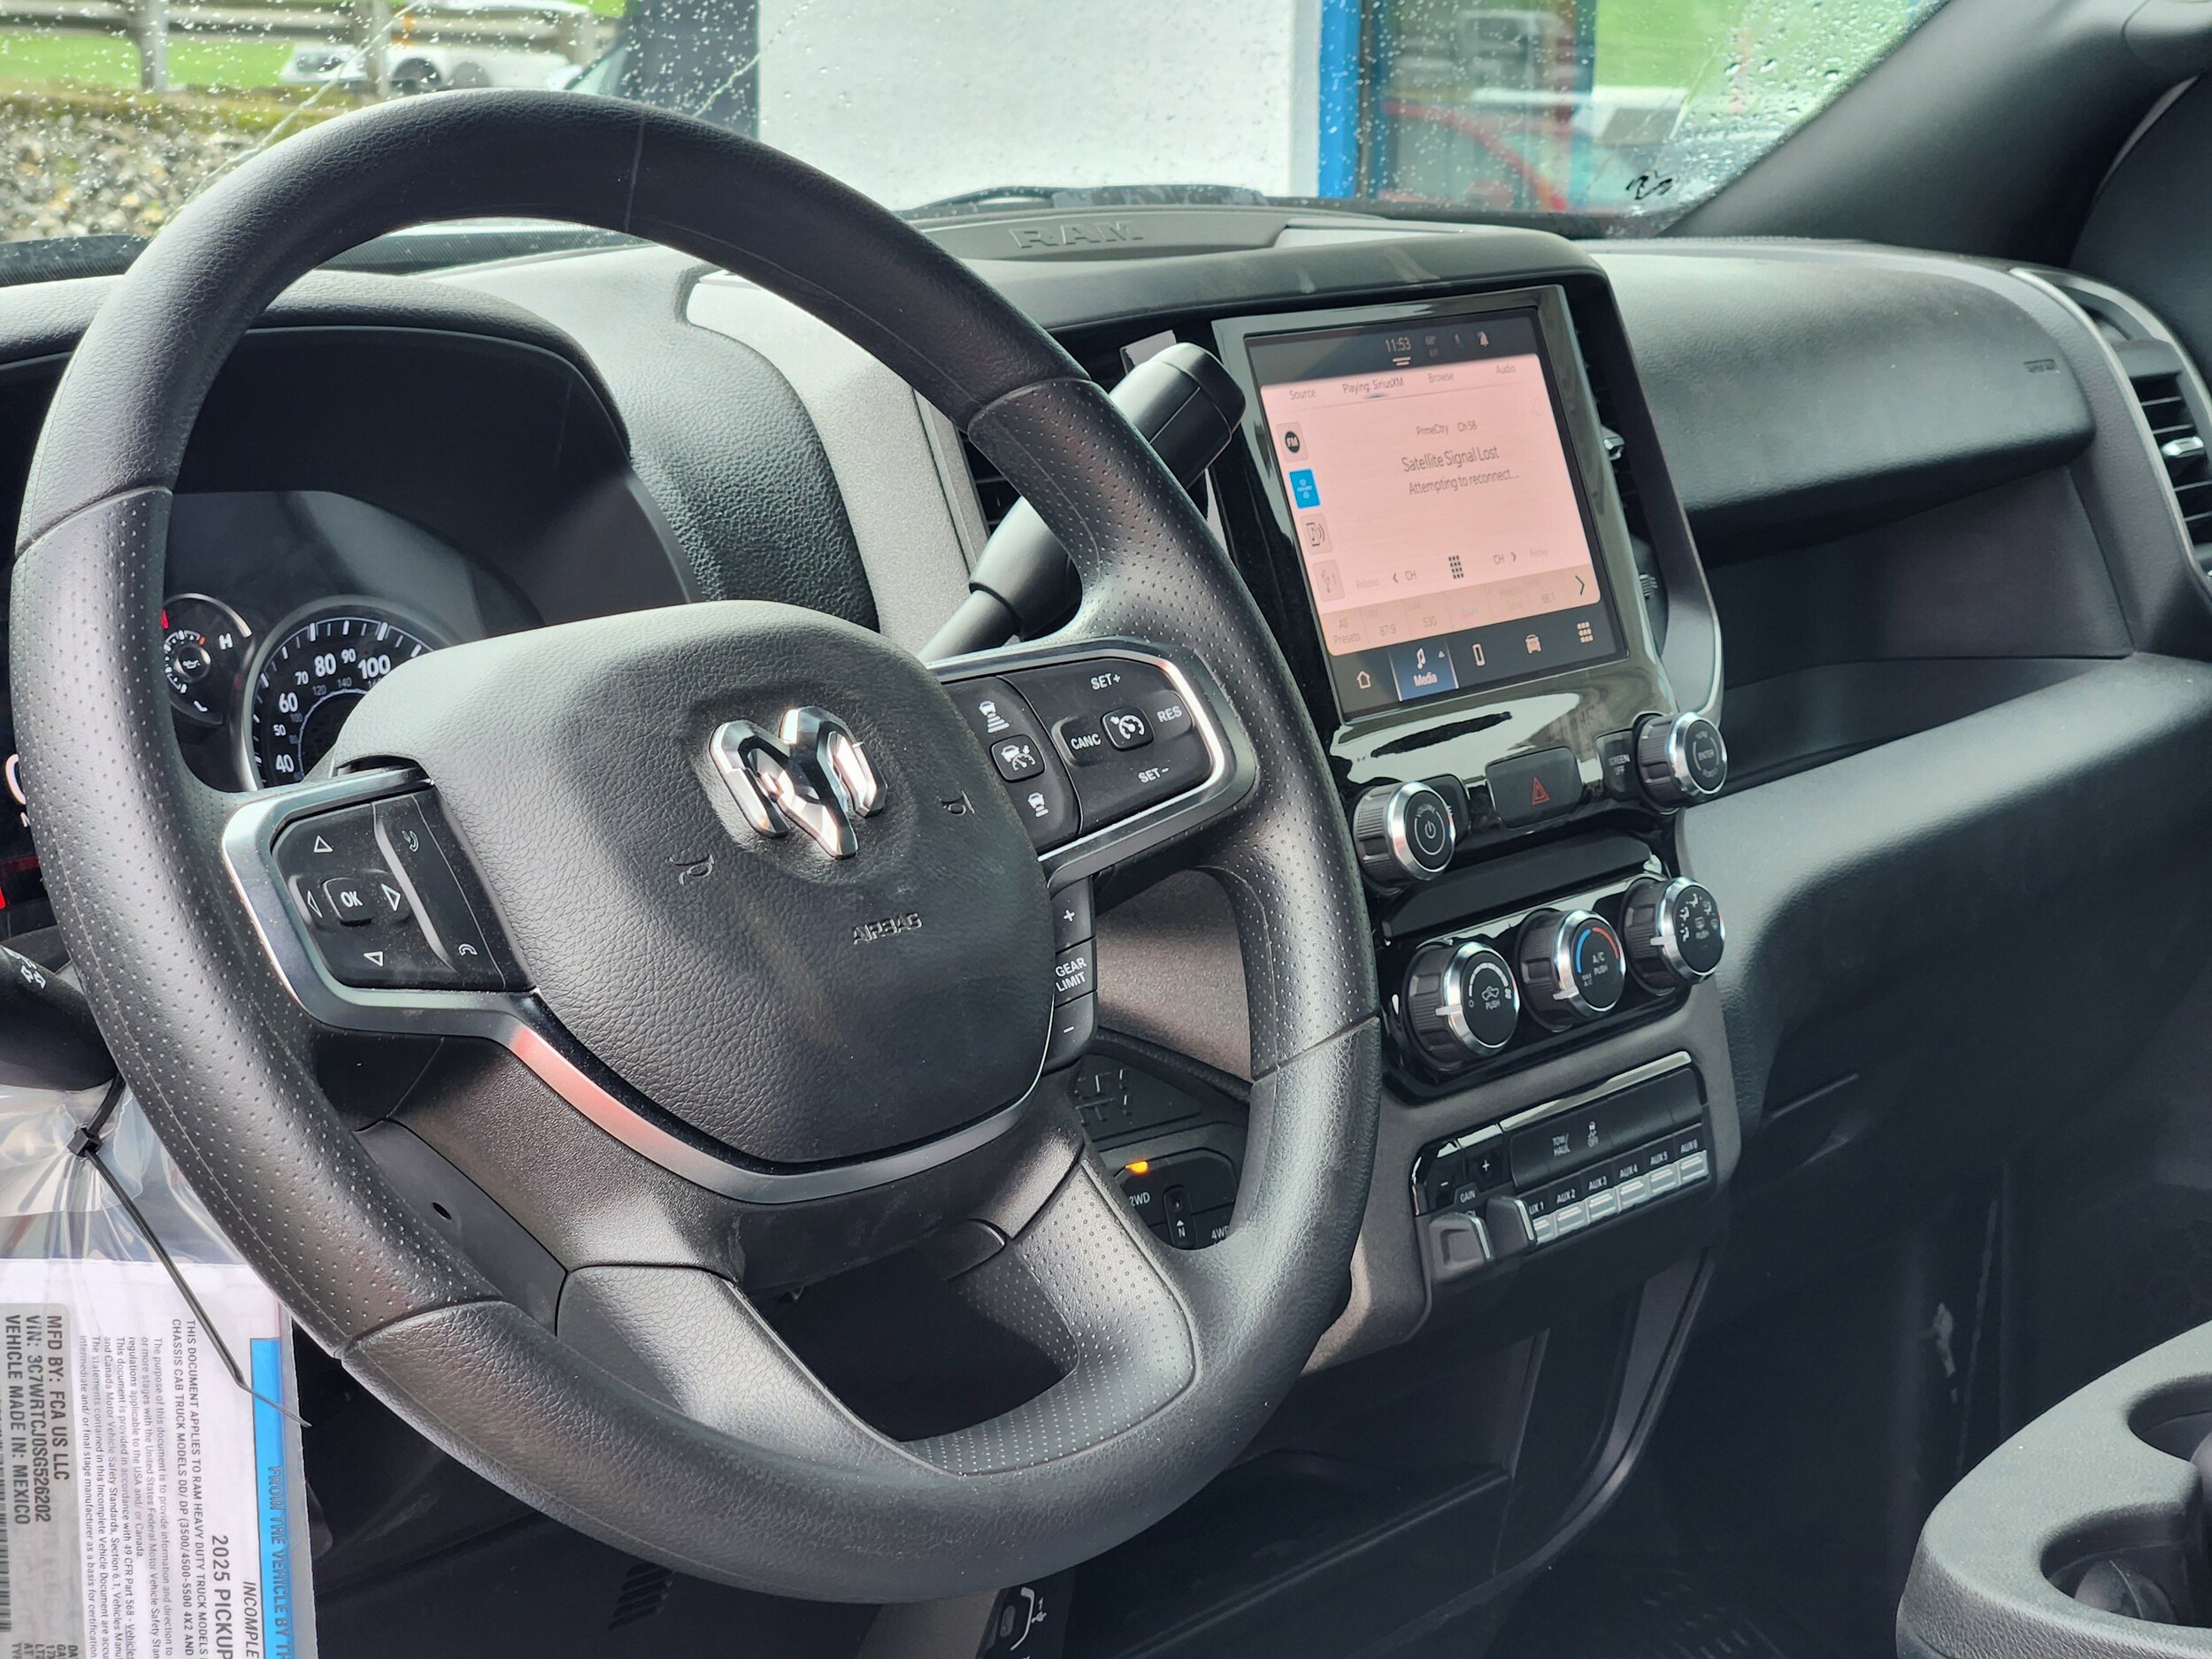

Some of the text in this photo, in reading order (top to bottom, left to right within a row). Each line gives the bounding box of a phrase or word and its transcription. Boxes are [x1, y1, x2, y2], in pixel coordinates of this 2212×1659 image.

[1009, 221, 1144, 249] RAM
[1385, 336, 1411, 353] 11:53
[1427, 372, 1455, 383] Browse
[1495, 364, 1517, 375] Audio
[1289, 388, 1317, 401] Source
[1342, 377, 1405, 395] Playing: SiriusXM
[1401, 445, 1500, 472] Satellite Signal Lost
[1409, 475, 1459, 495] Attempting
[1494, 554, 1504, 565] CH
[1405, 570, 1417, 580] CH
[1423, 616, 1438, 627] 530
[219, 633, 234, 650] H
[1333, 633, 1361, 644] Presets
[314, 653, 336, 679] 80
[341, 648, 357, 664] 90
[357, 654, 391, 680] 100
[295, 670, 309, 686] 70
[337, 676, 352, 688] 140
[1090, 672, 1121, 691] SET+
[1413, 671, 1438, 687] Media
[312, 684, 326, 696] 120
[279, 692, 299, 713] 60
[1156, 705, 1182, 723] RES
[273, 724, 286, 737] 50
[1071, 733, 1102, 750] CANC
[275, 754, 295, 774] 40
[1697, 749, 1715, 761] ENTER
[341, 890, 363, 908] OK
[851, 912, 922, 945] AIRBAG
[1055, 956, 1087, 978] GEAR
[1593, 951, 1606, 964] A/C
[1055, 971, 1087, 993] LIMIT
[1485, 999, 1501, 1010] PUSH
[1679, 1141, 1692, 1154] AUX
[1649, 1154, 1662, 1166] AUX
[1618, 1164, 1639, 1179] AUX 4
[1587, 1179, 1601, 1191] AUX
[1129, 1192, 1150, 1207] 2WD
[1460, 1189, 1476, 1203] GAIN
[1556, 1188, 1576, 1204] AUX 2
[1178, 1226, 1186, 1238] N
[26, 1316, 42, 1347] VIN:
[5, 1315, 23, 1379] VEHICLE
[117, 1338, 126, 1356] This
[154, 1338, 163, 1354] The
[80, 1336, 88, 1392] intermediate
[127, 1337, 138, 1386] regulations
[117, 1359, 126, 1402] document
[153, 1357, 164, 1393] purpose
[47, 1316, 70, 1479] MFD BY: FCA US LLC
[142, 1375, 150, 1405] stages
[9, 1386, 26, 1430] MADE
[81, 1394, 90, 1414] and/
[156, 1396, 165, 1405] of
[129, 1390, 140, 1435] applicable
[156, 1408, 165, 1424] this
[119, 1416, 129, 1454] provided
[12, 1437, 27, 1458] IN:
[157, 1427, 166, 1471] document
[81, 1451, 91, 1476] stage
[145, 1446, 154, 1474] United
[13, 1464, 30, 1525] MEXICO
[93, 1356, 110, 1617] statements contained Incomplete Vehicle Document
[104, 1356, 122, 1630] Canada Motor Vehicle Safety Standards, Section Vehicles
[121, 1468, 131, 1520] accordance
[147, 1477, 156, 1504] States
[159, 1485, 167, 1494] to
[173, 1319, 194, 1655] CHASSIS CAB TRUCK MODELS DP (3500/4500-5500 4X2 AND
[187, 1320, 209, 1655] THIS DOCUMENT APPLIES TO RAM HEAVY DUTY TRUCK MODELS
[268, 1466, 285, 1509] FROM
[84, 1479, 94, 1539] manufacturer
[157, 1497, 168, 1529] provide
[124, 1524, 133, 1541] with
[148, 1509, 157, 1540] Federal
[271, 1515, 286, 1545] THE
[124, 1545, 133, 1555] 49
[135, 1524, 145, 1559] Canada.
[149, 1544, 157, 1571] Motor
[161, 1532, 171, 1584] information
[87, 1563, 96, 1586] basis
[273, 1549, 289, 1613] VEHICLE
[125, 1578, 134, 1596] Part
[150, 1573, 159, 1605] Vehicle
[163, 1586, 172, 1602] and
[212, 1535, 233, 1659] 2025 PICKUP
[126, 1600, 134, 1616] 568
[150, 1609, 160, 1636] Safety
[163, 1605, 173, 1644] direction
[243, 1581, 258, 1658] INCOMPLE
[275, 1617, 290, 1636] BY
[24, 1643, 34, 1655] AT
